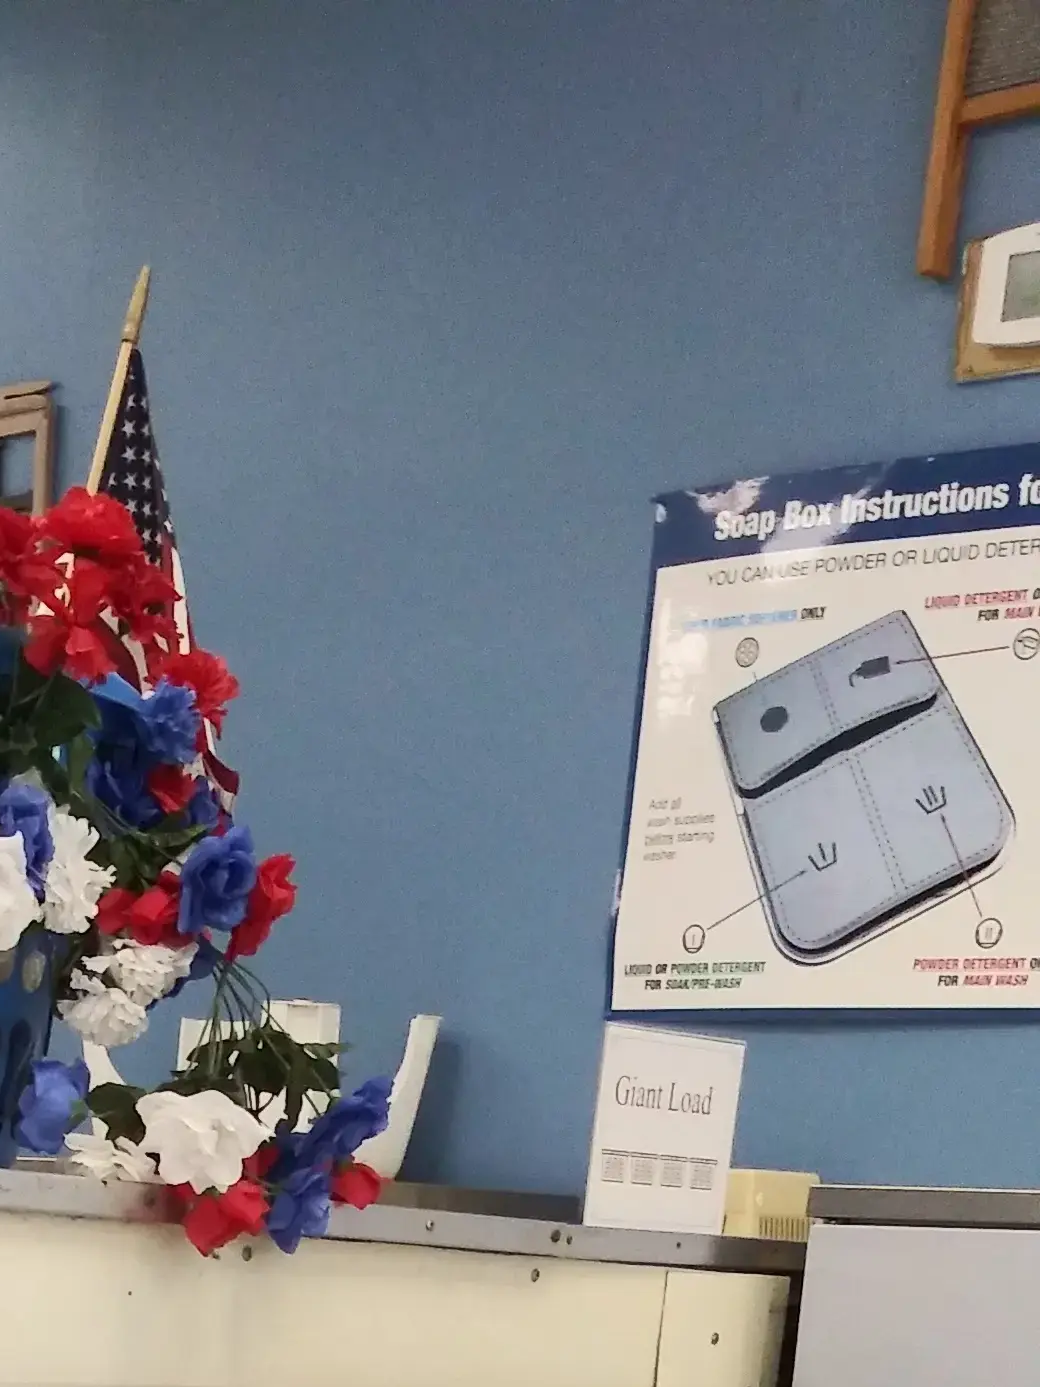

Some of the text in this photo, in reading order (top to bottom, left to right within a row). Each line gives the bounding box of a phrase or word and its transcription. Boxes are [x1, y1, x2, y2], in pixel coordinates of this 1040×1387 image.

[714, 509, 775, 541] Soap
[783, 499, 833, 531] Box
[841, 481, 1009, 523] Instructions
[708, 569, 736, 587] YOU
[815, 552, 887, 573] POWDER
[893, 549, 917, 567] OR
[923, 543, 980, 565] LIQUID
[712, 961, 766, 974] DETERGENT
[938, 975, 959, 986] FOR
[615, 1075, 714, 1116] Giant Load
